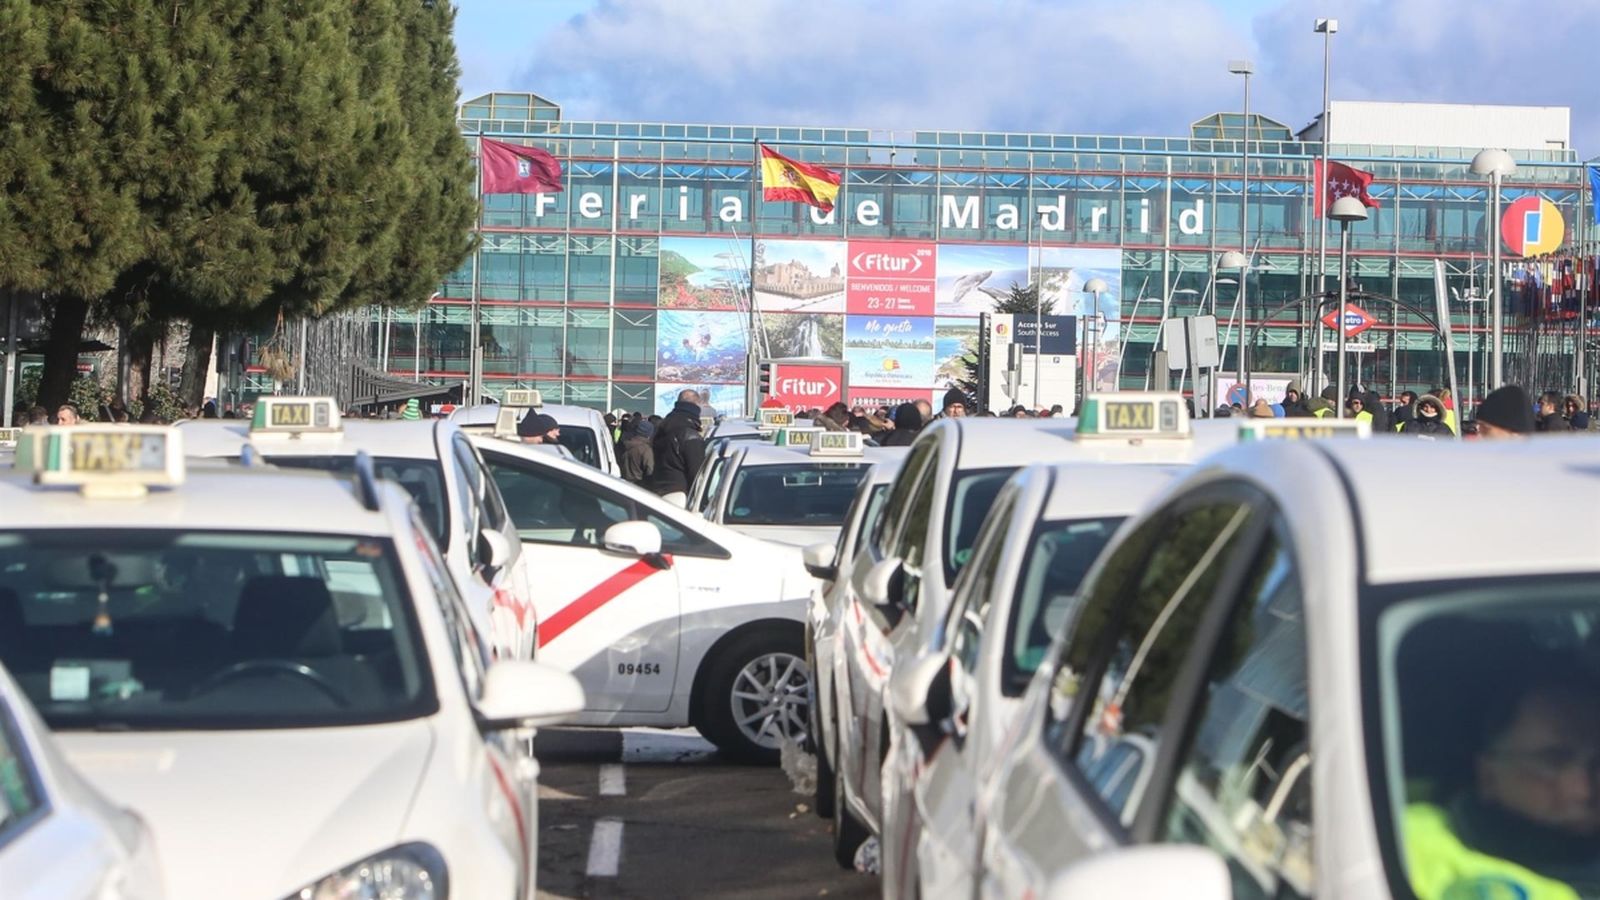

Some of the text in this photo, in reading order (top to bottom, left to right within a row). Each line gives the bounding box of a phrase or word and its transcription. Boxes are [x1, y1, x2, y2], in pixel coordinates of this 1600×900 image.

[535, 186, 743, 223] Feria
[942, 194, 1204, 235] Madrid
[865, 252, 910, 271] Fitur
[782, 378, 825, 396] Fitur
[273, 404, 310, 425] TAXI
[1107, 403, 1154, 428] TAXI
[822, 434, 847, 448] TAXI
[72, 432, 142, 472] TAXI
[618, 663, 660, 675] 09454
